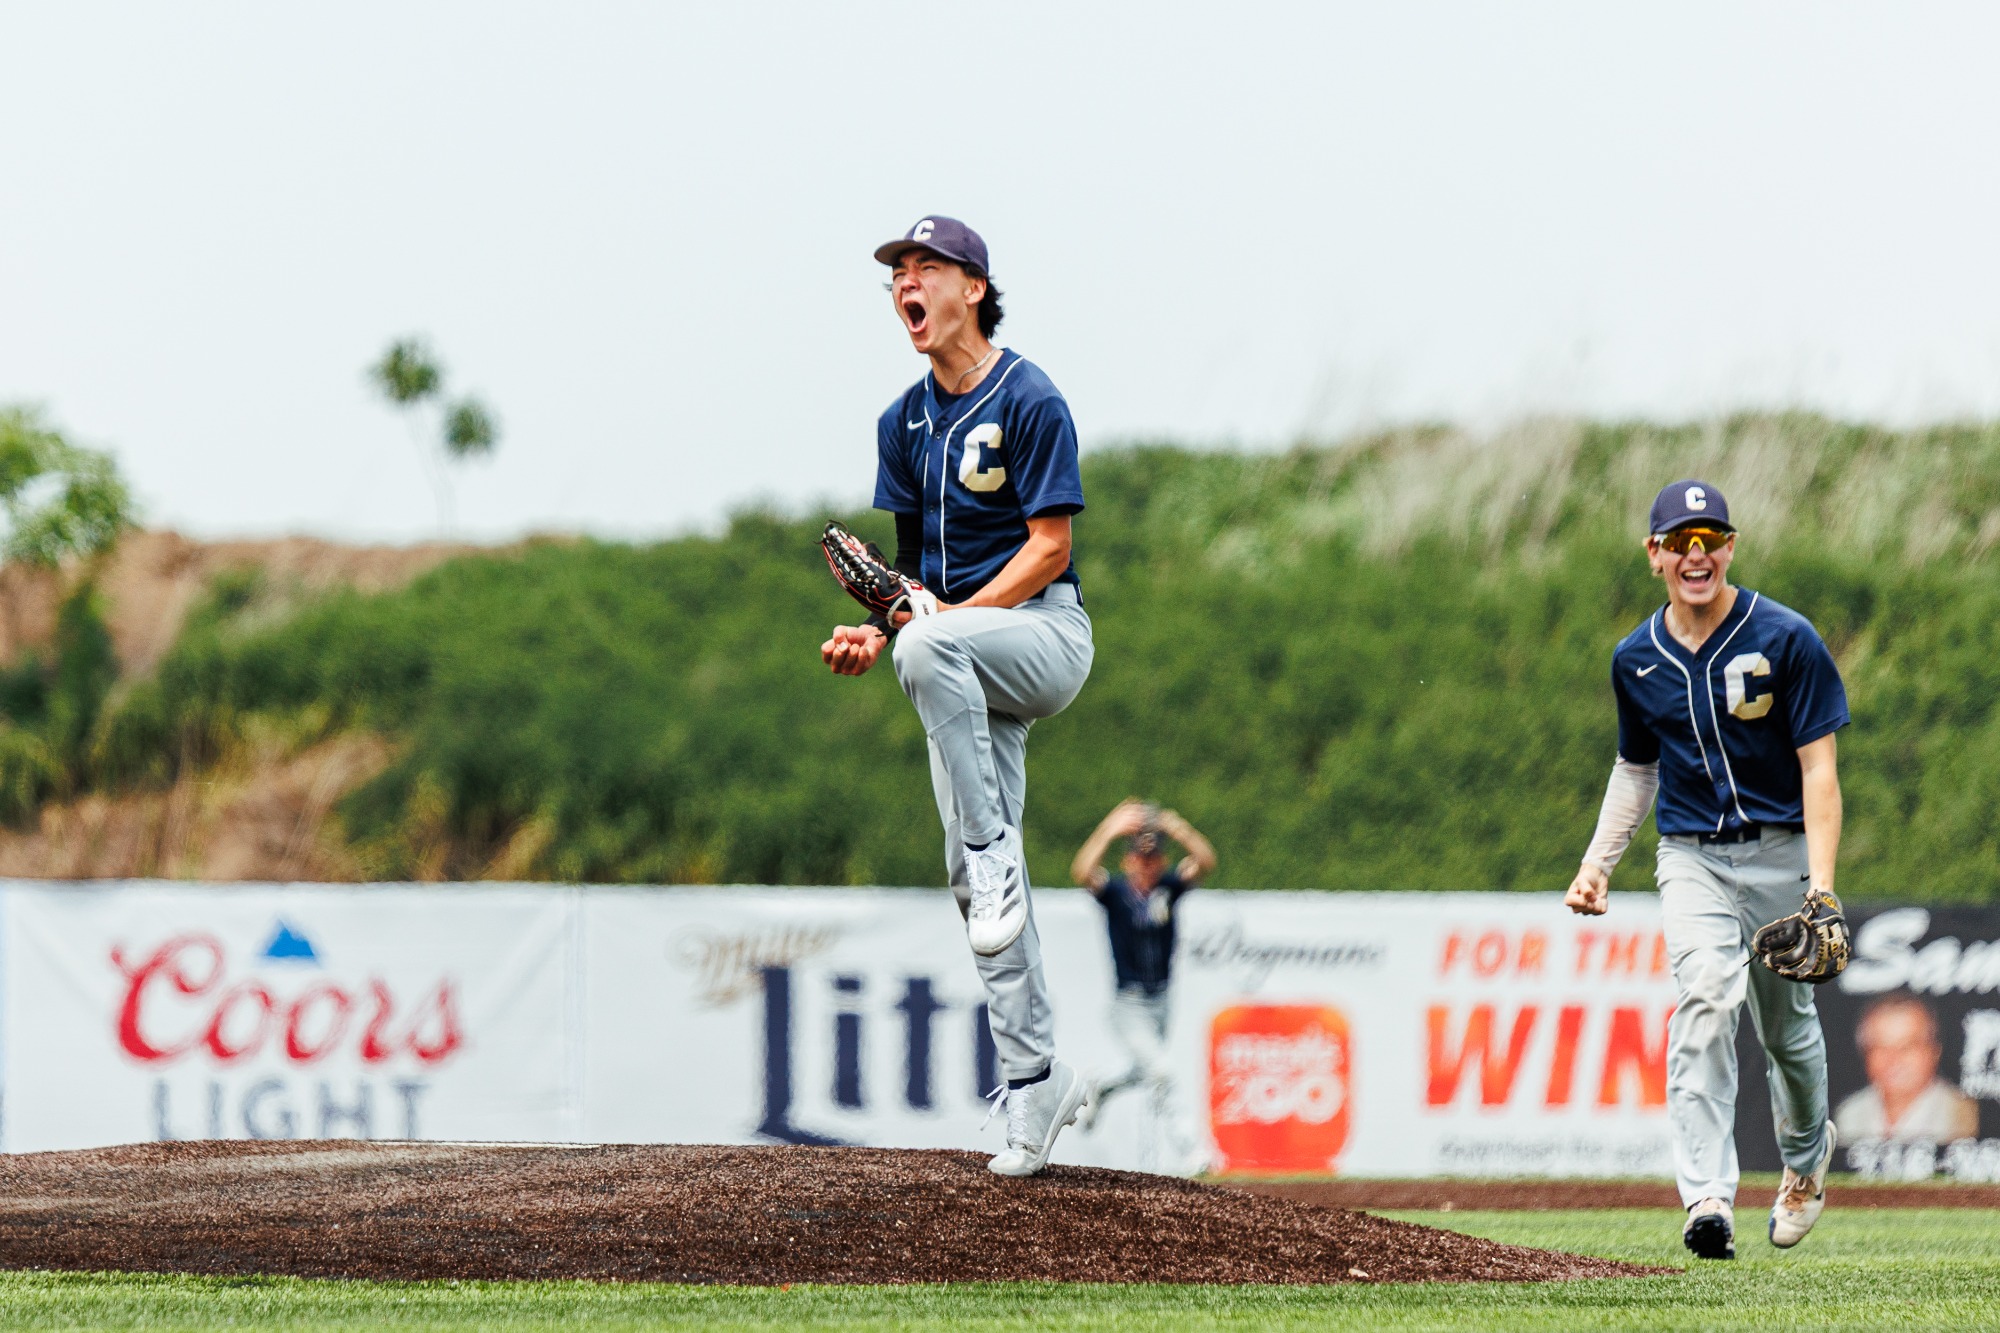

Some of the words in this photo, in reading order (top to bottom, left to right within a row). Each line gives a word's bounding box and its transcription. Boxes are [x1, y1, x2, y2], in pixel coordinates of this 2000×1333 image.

[913, 220, 935, 242] C
[959, 423, 1006, 492] C
[1684, 486, 1707, 511] C
[1723, 651, 1774, 721] C
[1439, 929, 1548, 975] FOR
[110, 934, 464, 1064] Coors
[1425, 1004, 1676, 1107] WIN
[151, 1077, 429, 1141] LIGHT
